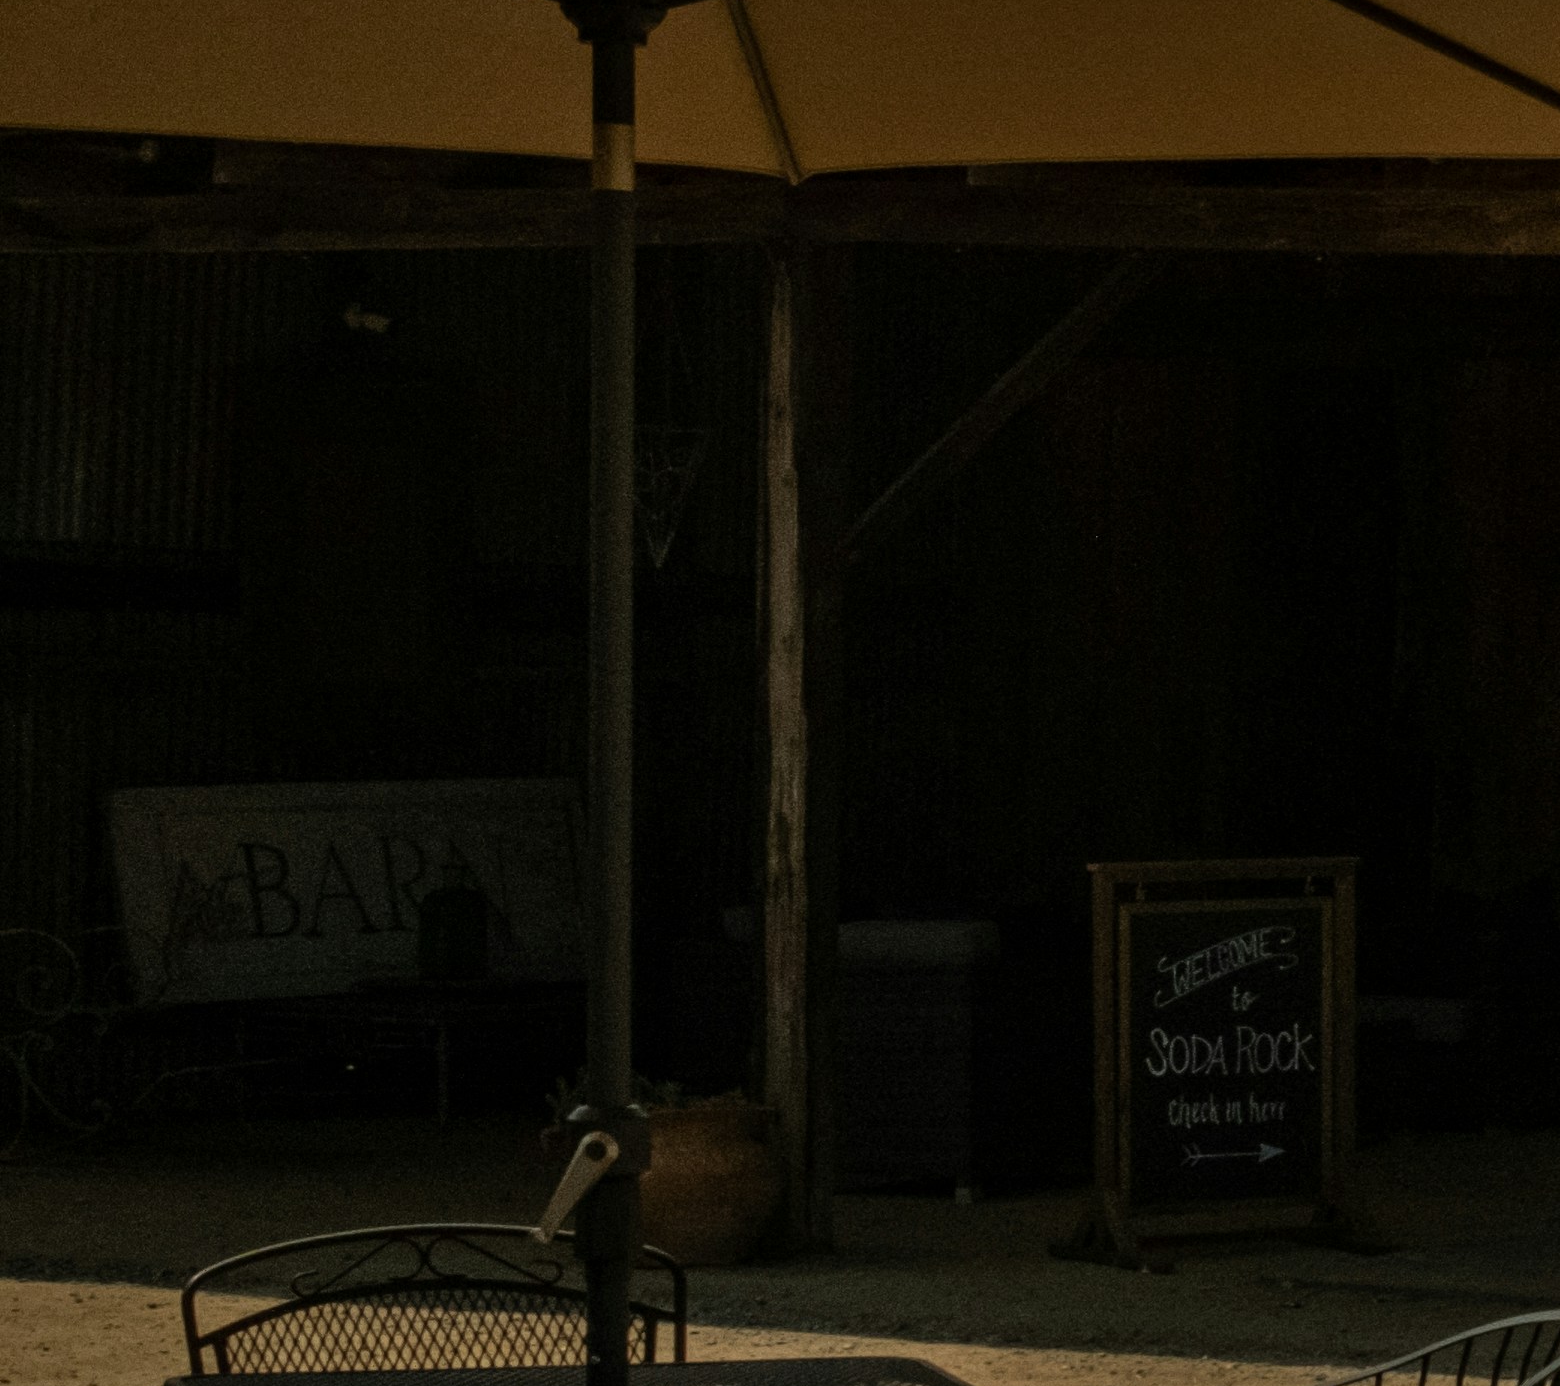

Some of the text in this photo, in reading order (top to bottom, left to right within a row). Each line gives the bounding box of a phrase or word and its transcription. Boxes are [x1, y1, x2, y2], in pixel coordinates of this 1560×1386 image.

[1172, 927, 1273, 997] WELCOME
[1230, 984, 1260, 1012] to
[1144, 1022, 1316, 1078] SODA ROCK
[1168, 1092, 1287, 1130] check in here
